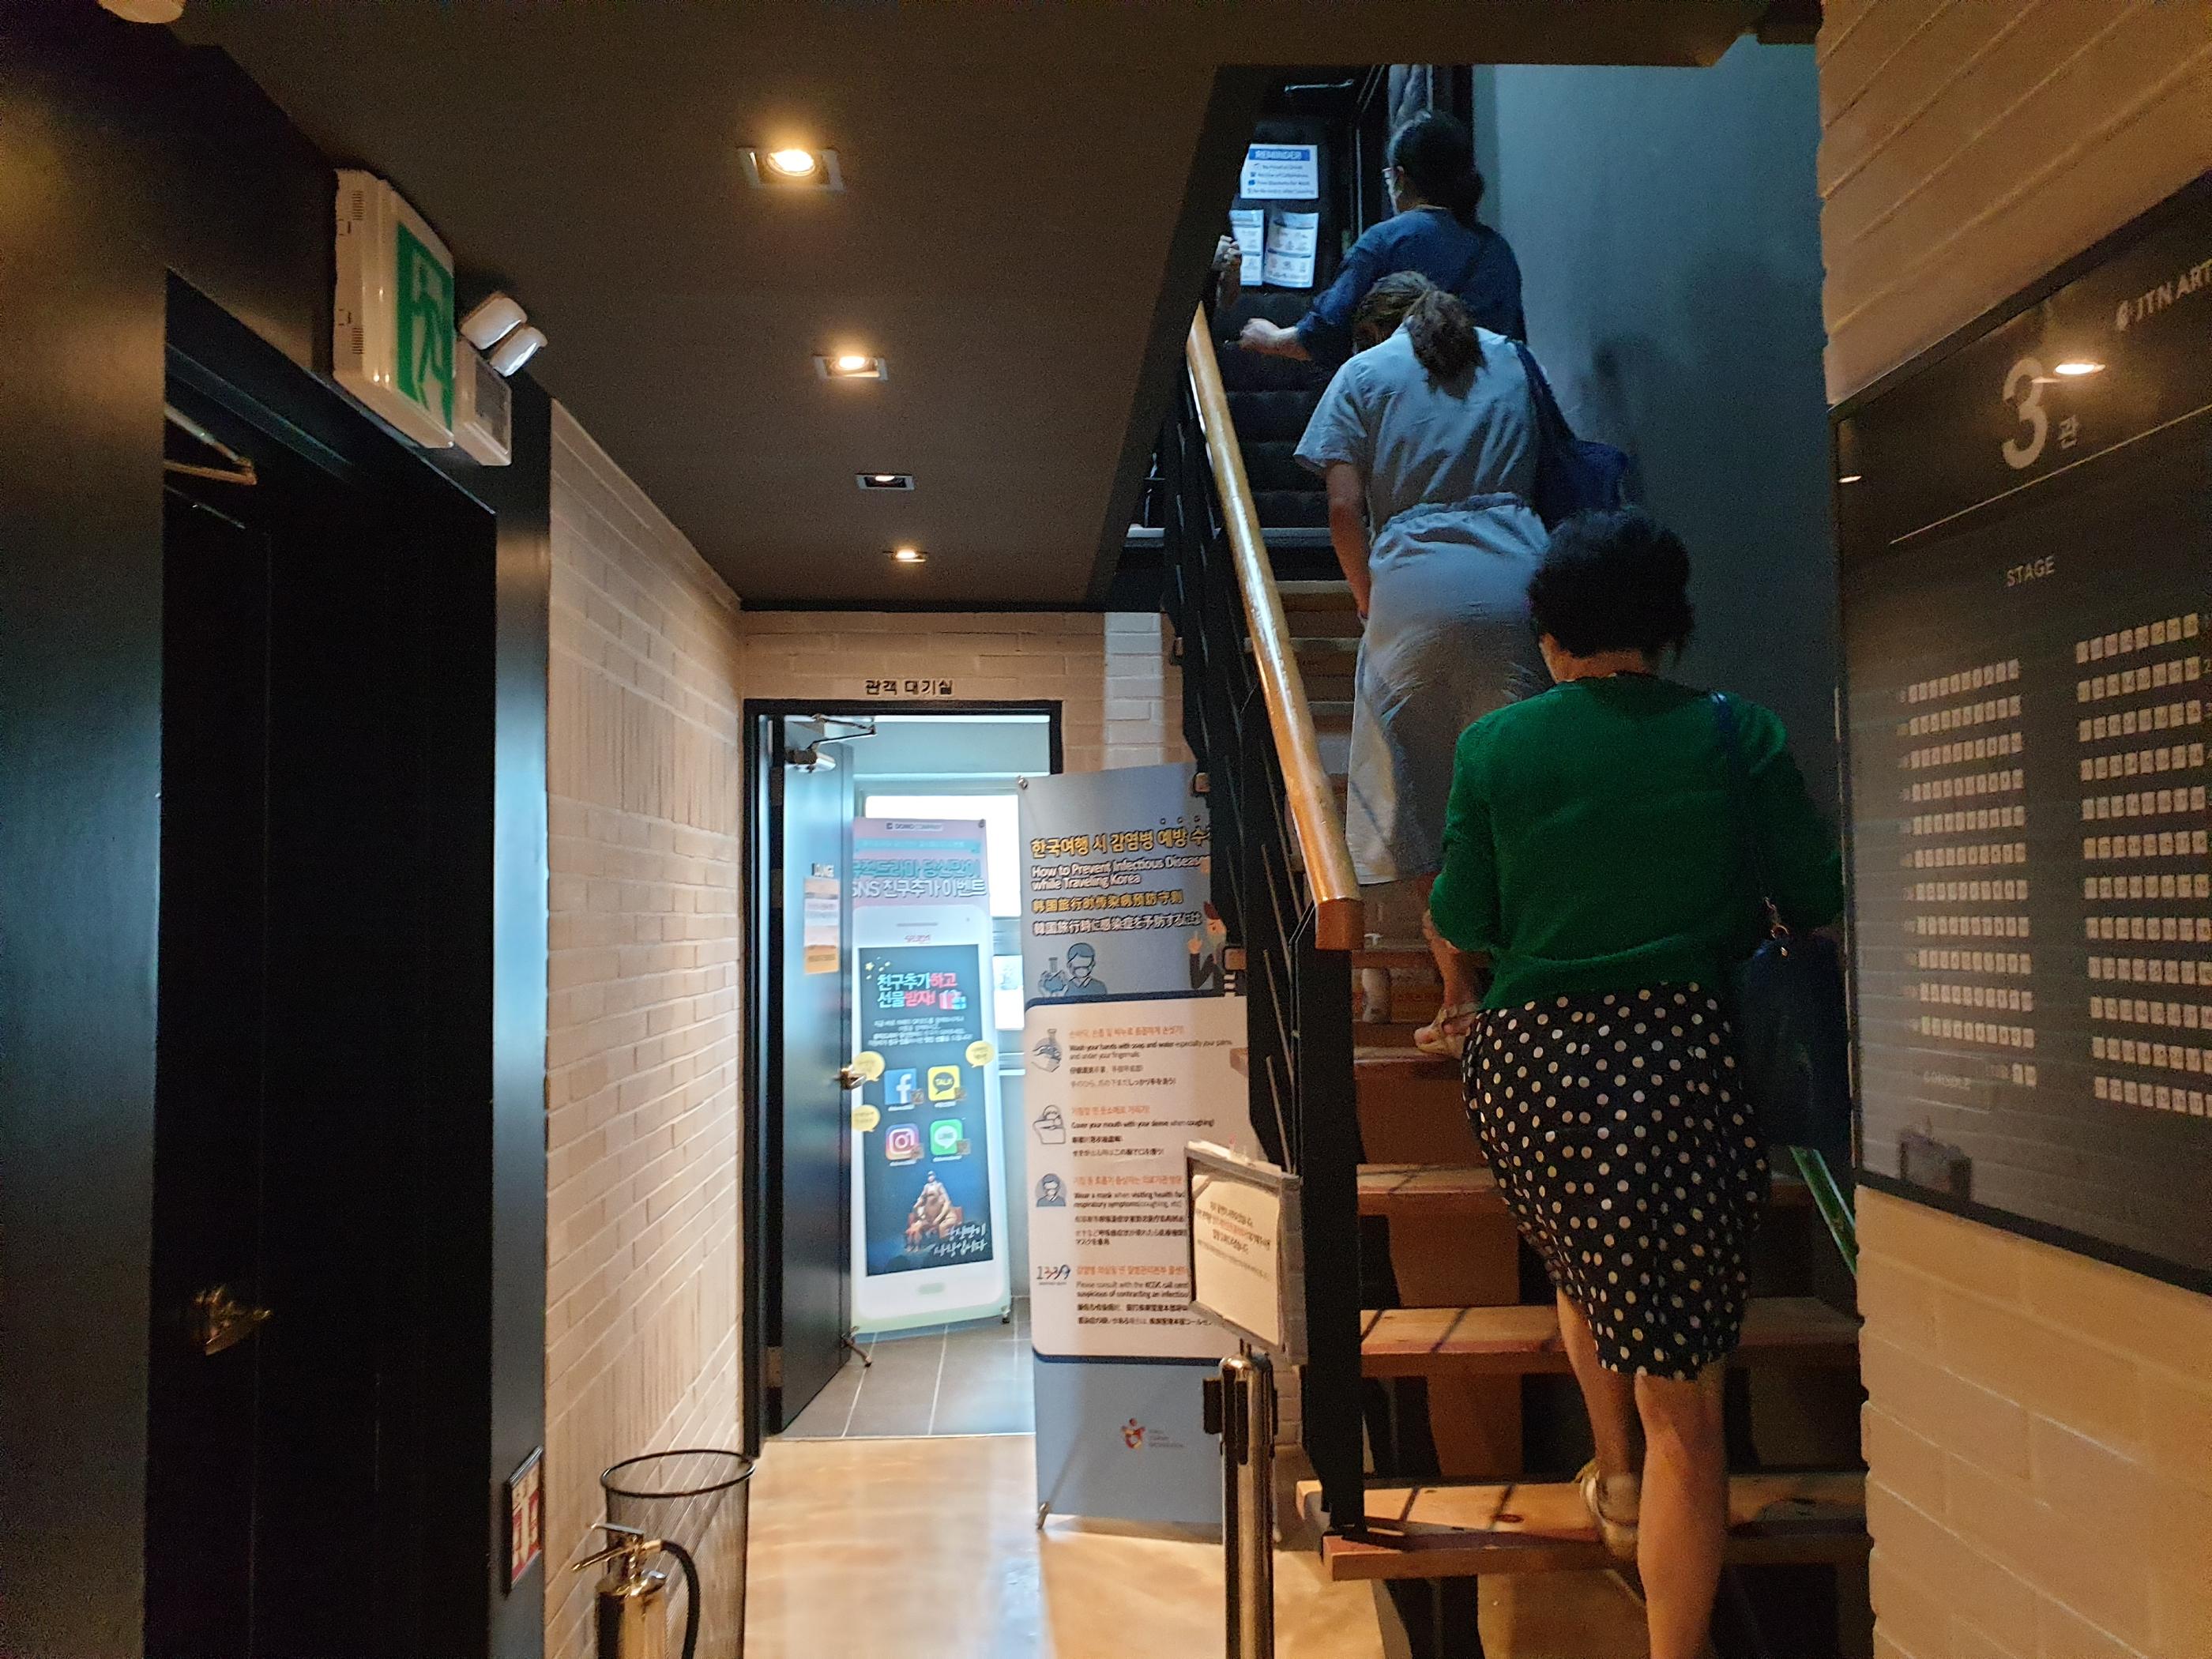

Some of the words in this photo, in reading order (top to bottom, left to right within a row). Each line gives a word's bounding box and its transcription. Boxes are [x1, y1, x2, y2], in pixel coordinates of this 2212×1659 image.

[2005, 555, 2055, 588] STAGE
[866, 679, 897, 695] 관객
[905, 679, 953, 695] 대기실
[1031, 834, 1090, 859] 한국여행
[1093, 833, 1108, 853] 시
[1110, 830, 1154, 853] 감염병
[1157, 826, 1188, 848] 예방
[1190, 825, 1211, 846] 수
[1032, 865, 1057, 879] How
[1059, 864, 1070, 877] to
[1071, 861, 1112, 876] Prevent
[1113, 857, 1164, 874] Infectious
[1032, 876, 1061, 890] while
[1063, 874, 1109, 890] Traveling
[1110, 873, 1142, 886] Korea
